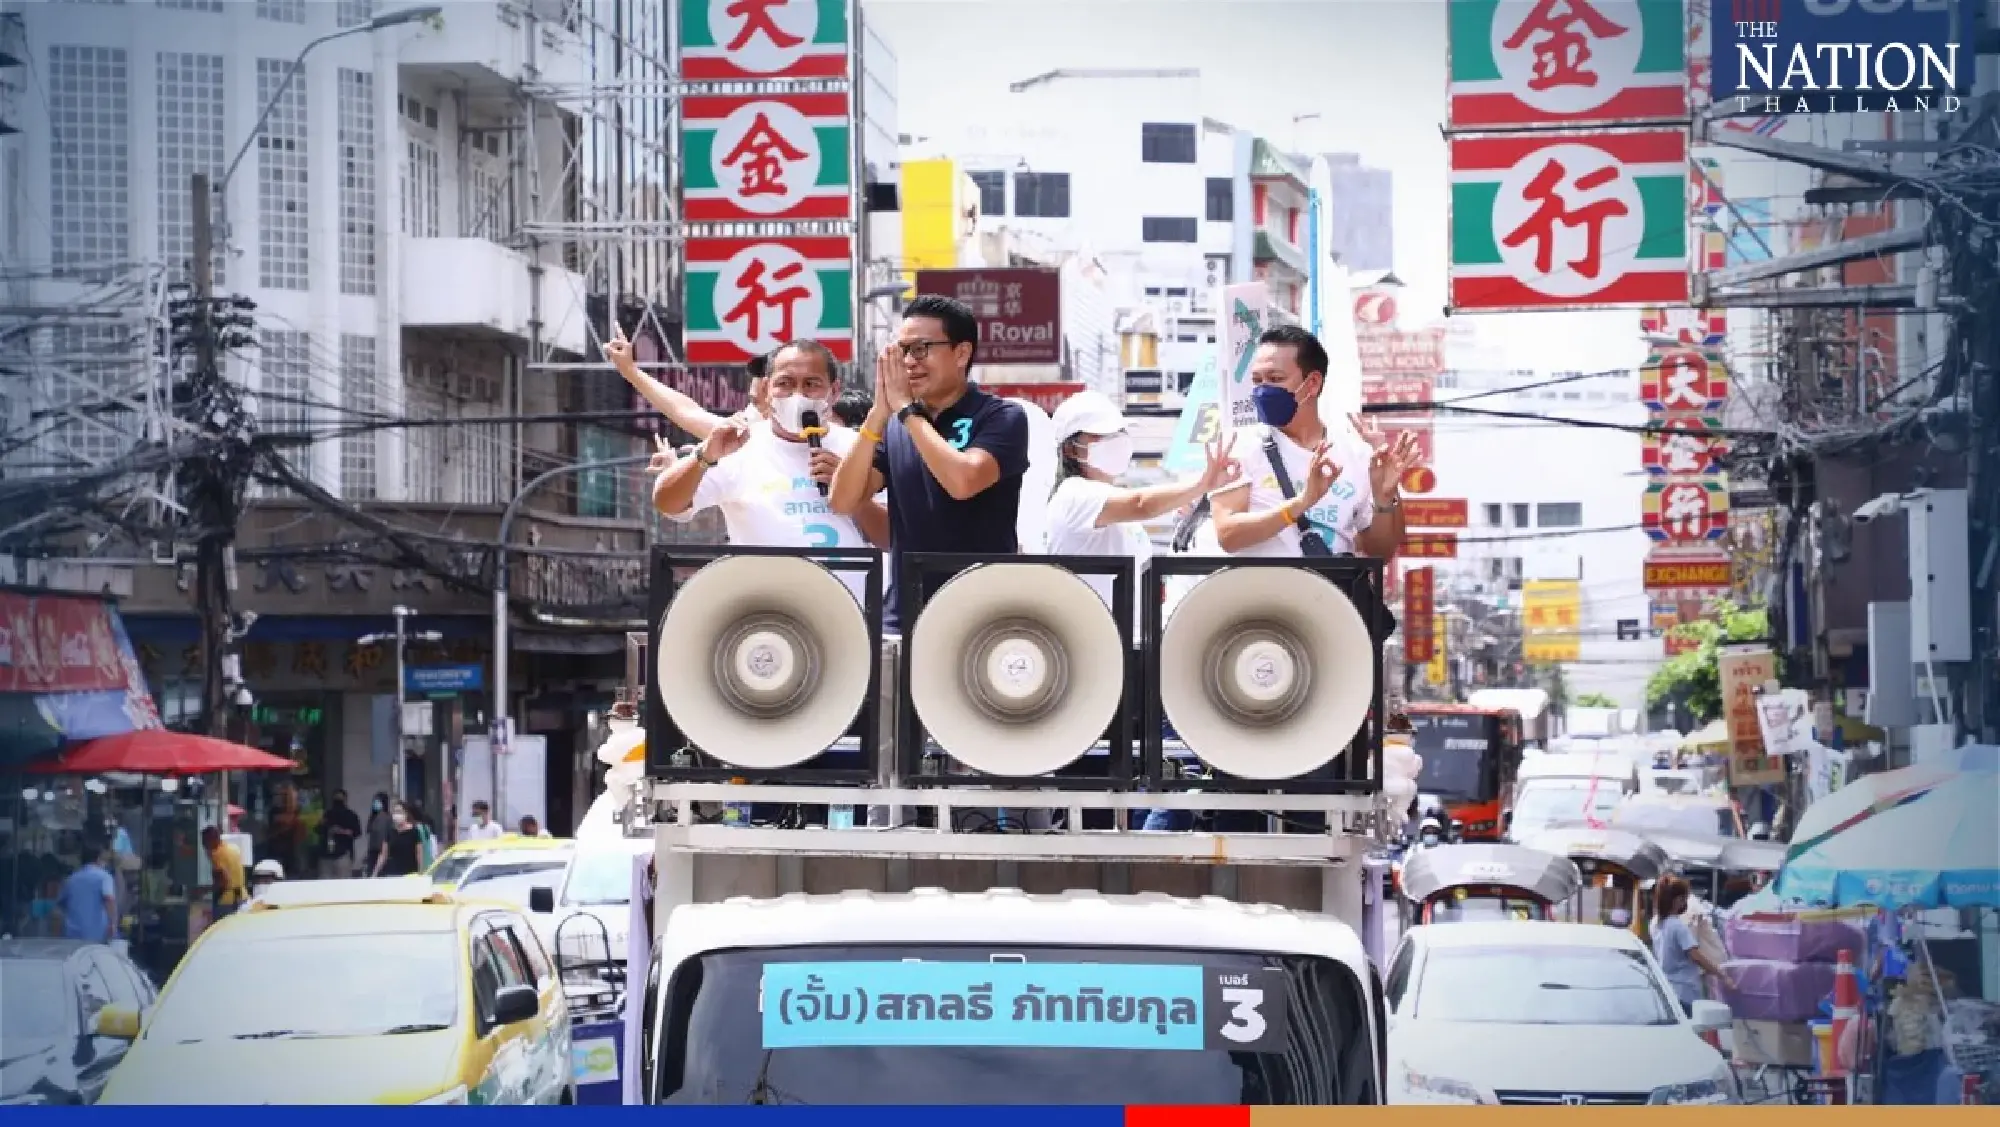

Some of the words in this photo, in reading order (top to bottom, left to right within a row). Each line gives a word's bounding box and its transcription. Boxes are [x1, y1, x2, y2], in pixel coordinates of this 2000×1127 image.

[1502, 0, 1629, 279] 金行
[989, 321, 1053, 344] Royal
[948, 418, 972, 451] 3
[784, 500, 830, 515] สกล
[1219, 974, 1249, 985] เบอร์
[779, 974, 868, 1026] (จั้ม)
[876, 982, 993, 1021] สกลธี
[1012, 984, 1197, 1035] ภัททิยกุล
[1218, 988, 1267, 1044] 3
